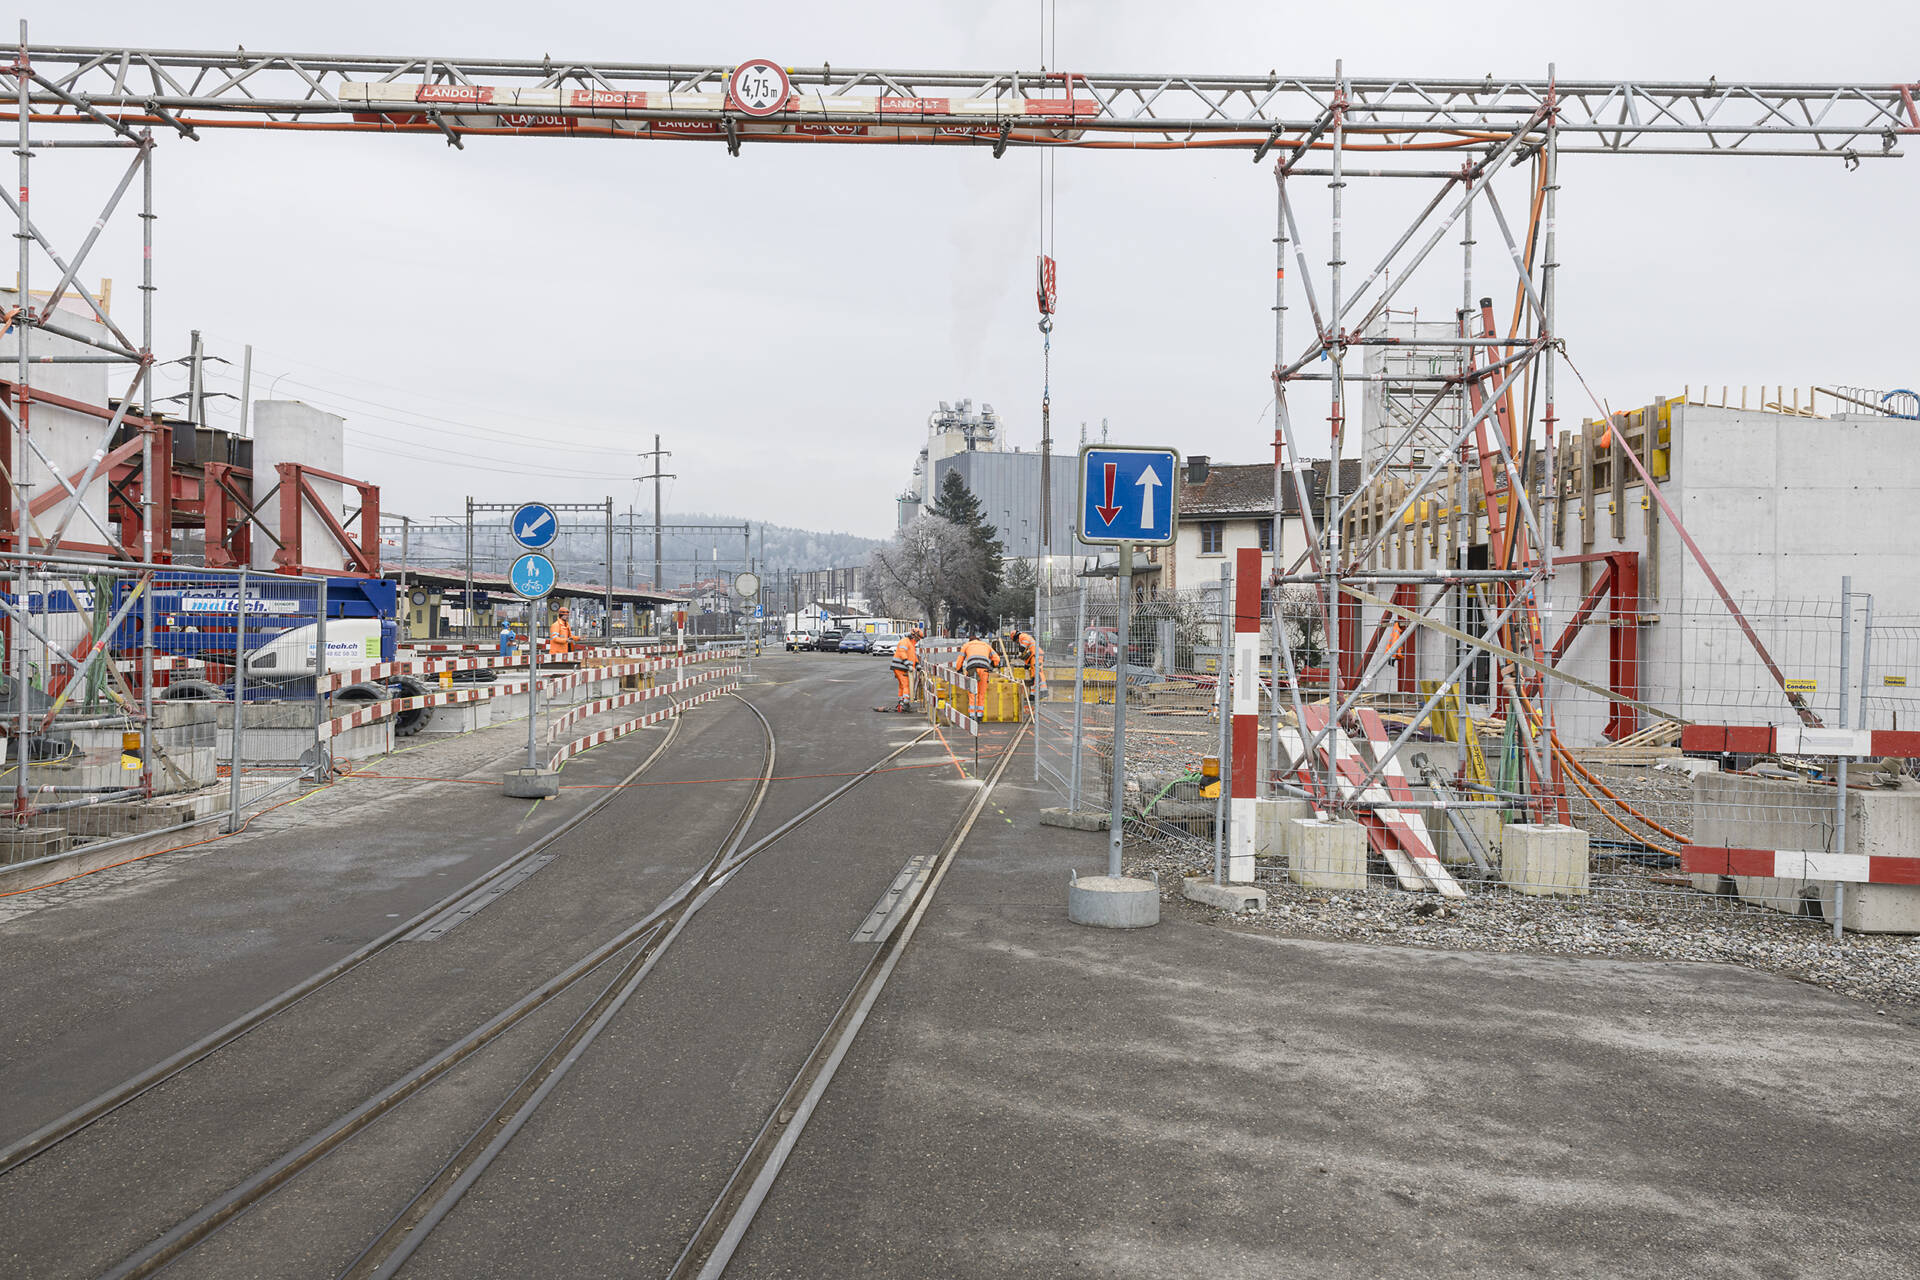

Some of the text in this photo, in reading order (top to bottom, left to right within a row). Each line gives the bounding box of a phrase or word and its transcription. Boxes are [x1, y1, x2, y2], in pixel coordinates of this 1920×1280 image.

[742, 74, 769, 99] 4,75
[424, 88, 486, 99] LANDOLT
[578, 93, 638, 103] LANDOLT
[881, 99, 939, 109] LANDOLT
